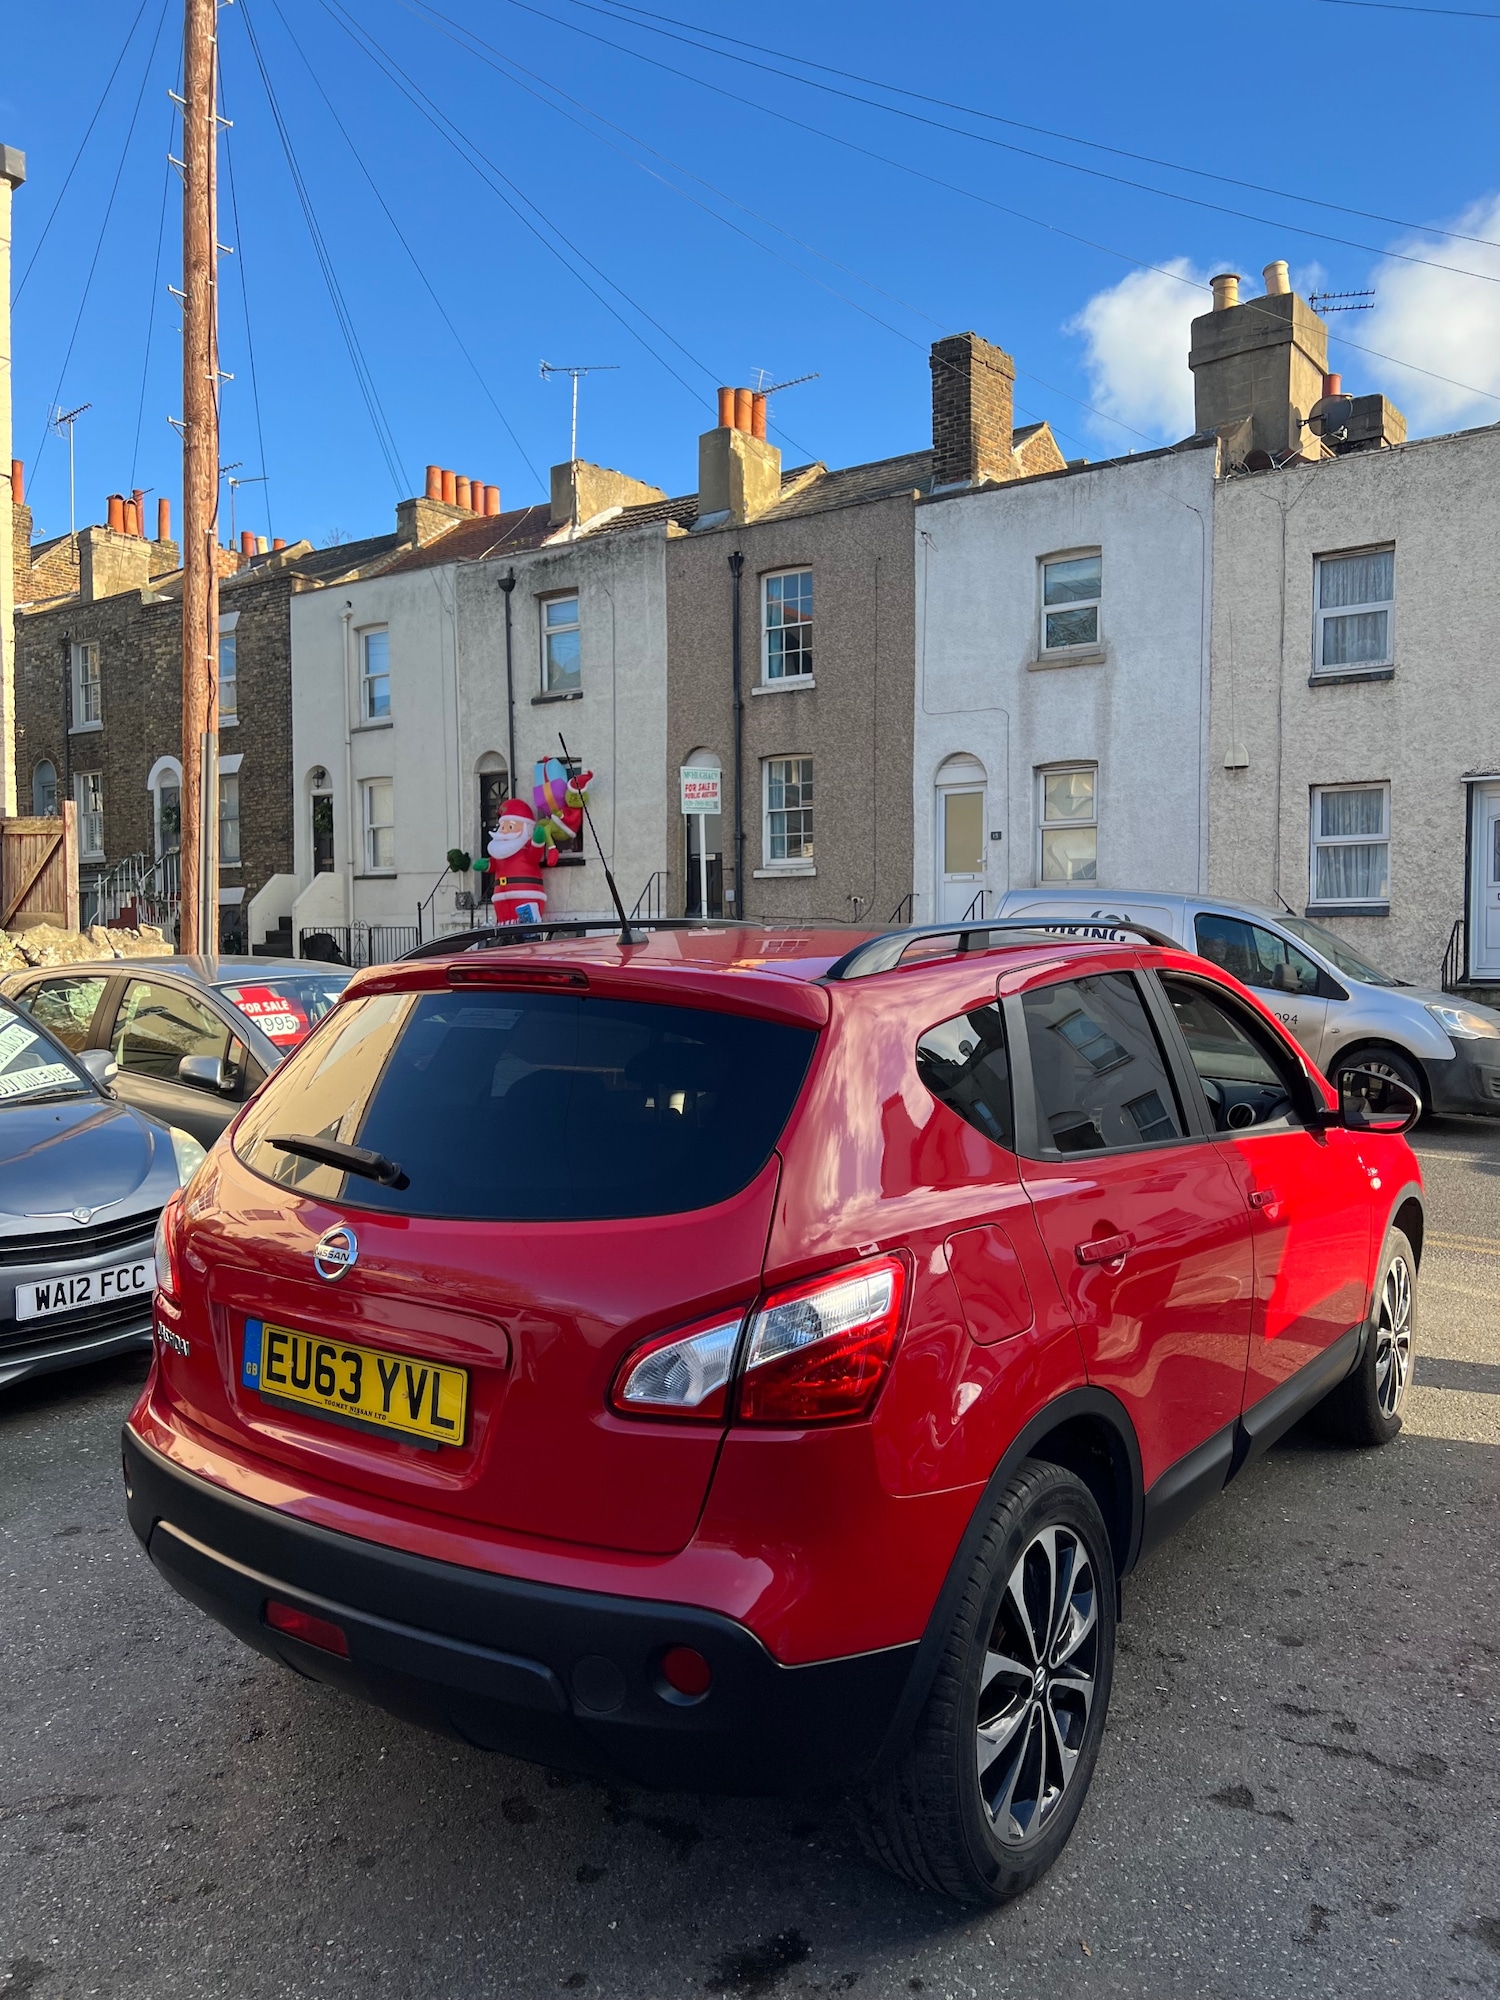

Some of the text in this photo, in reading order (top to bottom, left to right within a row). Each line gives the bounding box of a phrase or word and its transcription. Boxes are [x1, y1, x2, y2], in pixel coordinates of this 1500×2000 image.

[698, 783, 711, 791] SALE
[239, 1000, 290, 1013] FOR SALE
[18, 1066, 76, 1088] MILEAGE
[314, 1247, 350, 1261] NISSAN
[35, 1277, 91, 1311] WA12
[101, 1265, 145, 1297] FCC
[246, 1362, 258, 1376] GB
[266, 1331, 455, 1430] EU63 YVL
[349, 1405, 373, 1417] NISSAN
[374, 1412, 387, 1420] LTD
